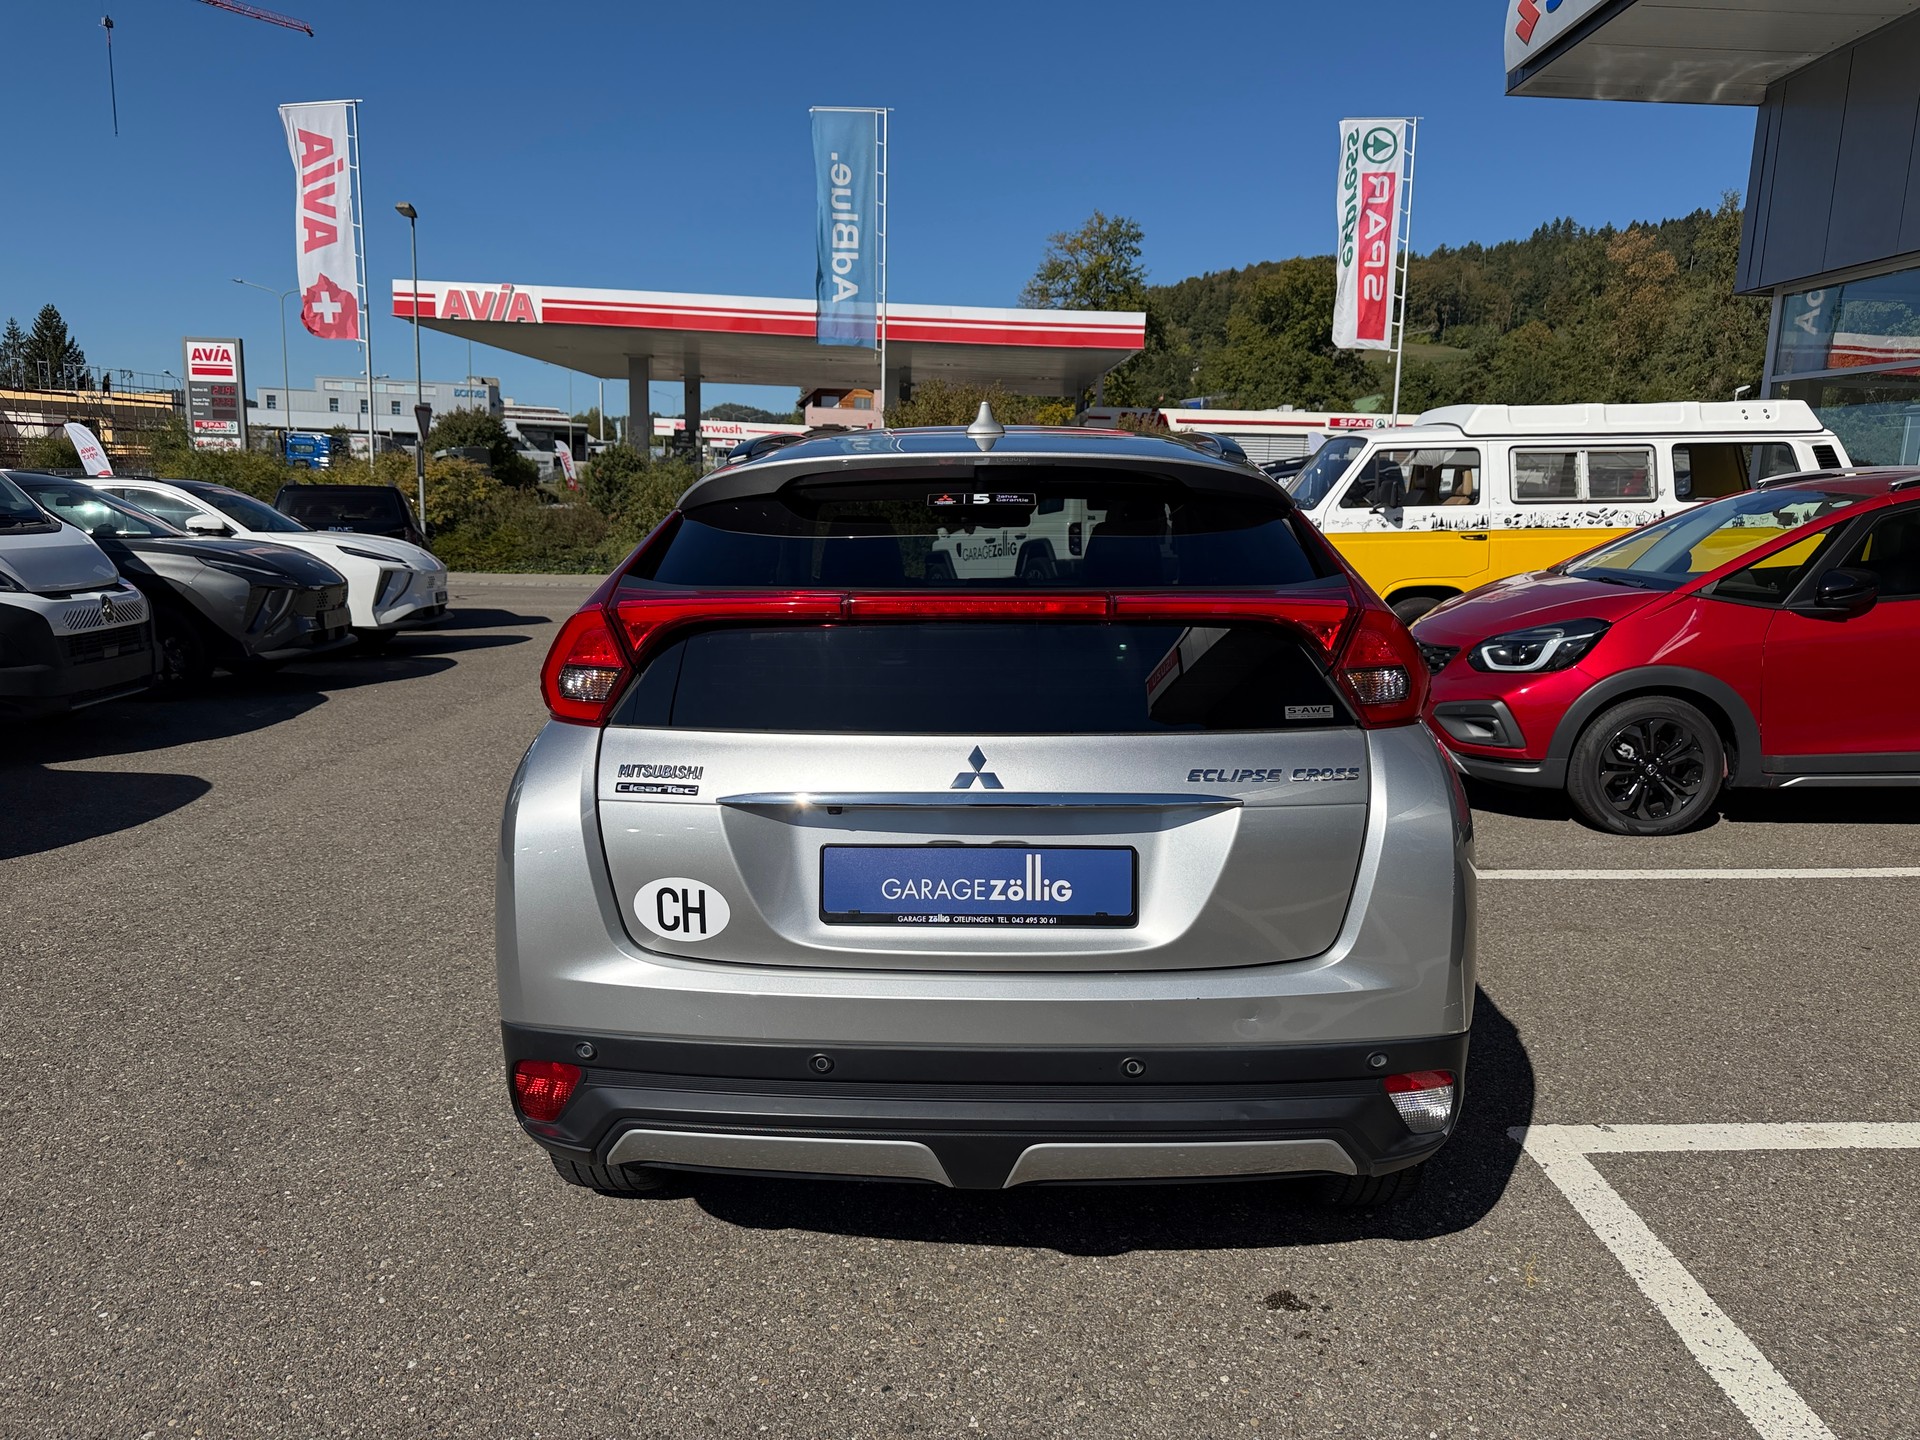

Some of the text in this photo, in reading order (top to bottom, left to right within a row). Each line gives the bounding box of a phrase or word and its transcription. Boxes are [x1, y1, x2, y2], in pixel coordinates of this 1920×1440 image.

[1339, 418, 1374, 427] SPAR
[973, 494, 990, 505] 5
[618, 764, 704, 780] MITSUBISHI
[1187, 767, 1360, 783] ECLIPSE CROSS
[616, 783, 698, 795] ClearTec
[656, 887, 707, 934] CH
